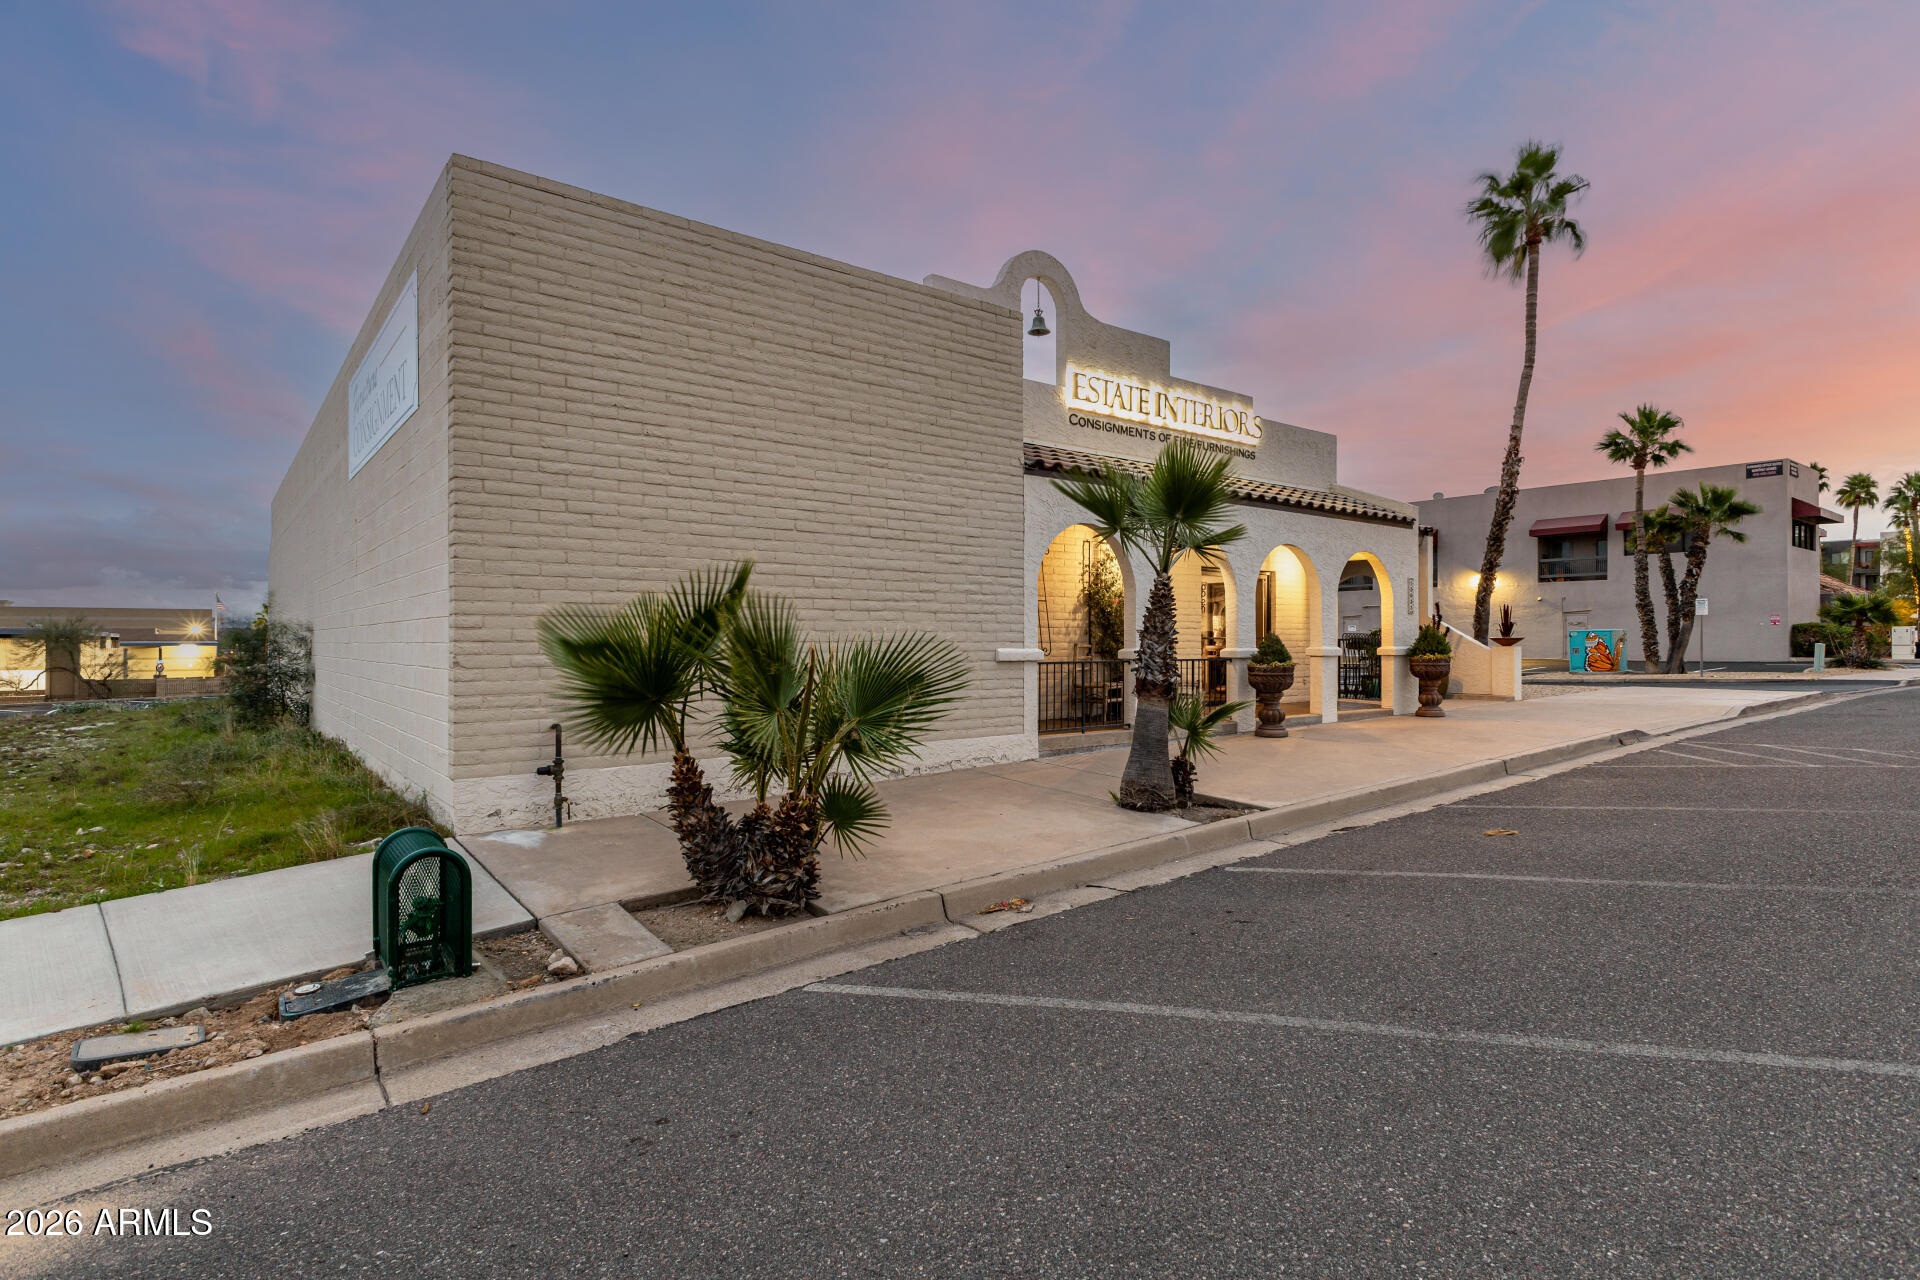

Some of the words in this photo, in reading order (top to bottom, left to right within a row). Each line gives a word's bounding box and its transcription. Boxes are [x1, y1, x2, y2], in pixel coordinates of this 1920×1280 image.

[1072, 372, 1150, 415] ESTATE
[1155, 391, 1263, 439] INTERIORS
[1069, 413, 1156, 441] CONSIGNMENTS
[1159, 432, 1171, 443] OF
[1197, 439, 1256, 461] FURNISHINGS
